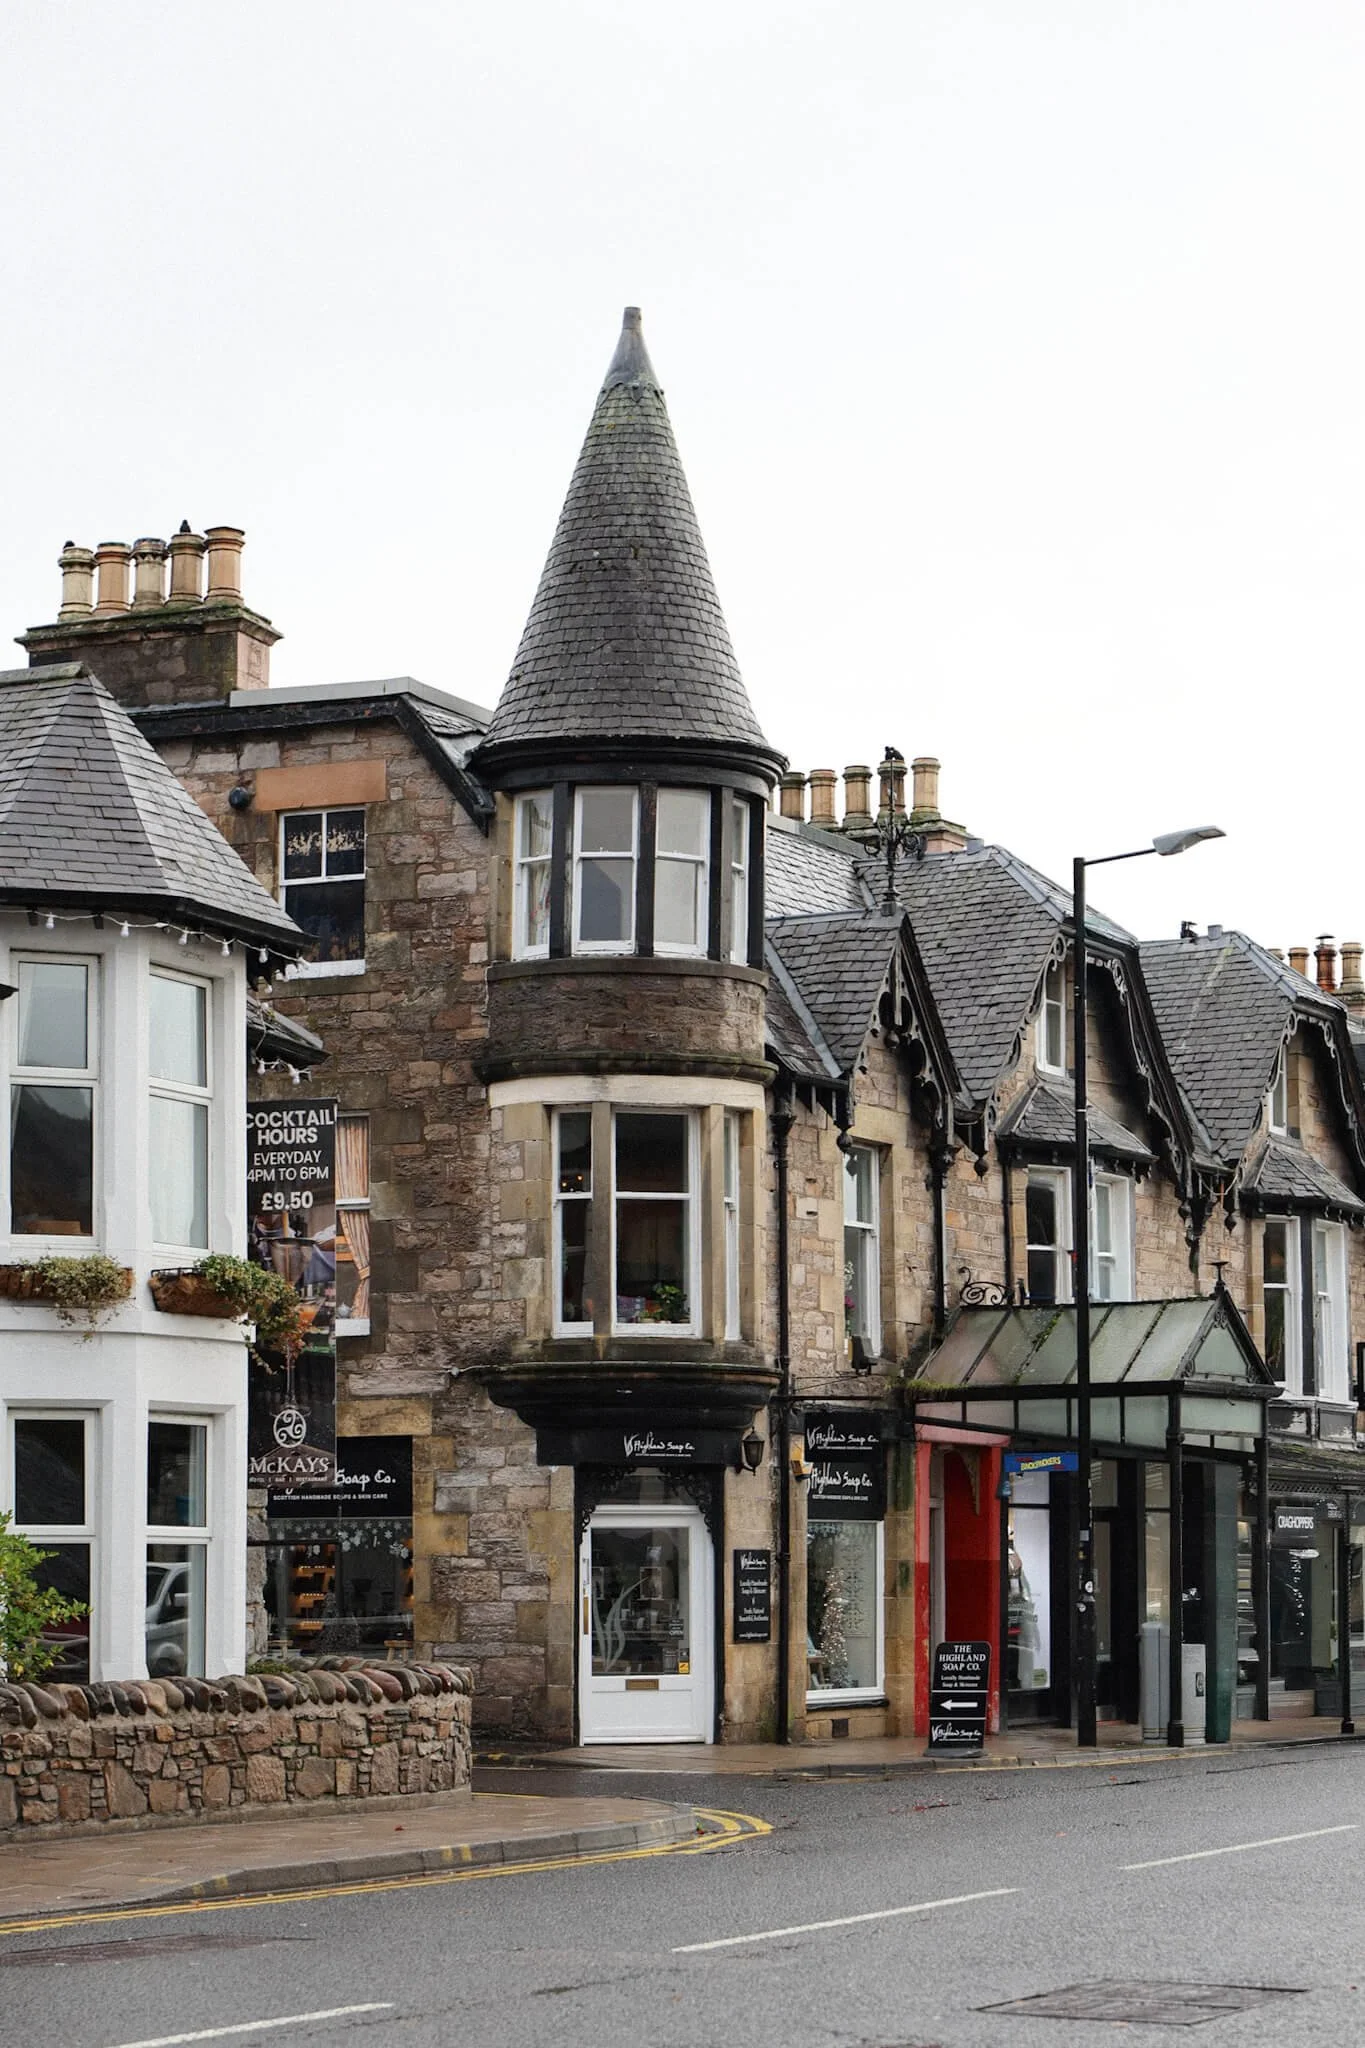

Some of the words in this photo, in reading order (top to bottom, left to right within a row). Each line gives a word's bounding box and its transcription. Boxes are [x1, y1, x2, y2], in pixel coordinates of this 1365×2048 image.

[246, 1108, 334, 1129] COCKTAIL
[257, 1127, 318, 1146] HOURS
[253, 1150, 322, 1166] EVERYDAY
[247, 1168, 275, 1183] 4PM
[279, 1167, 297, 1181] TO
[300, 1166, 329, 1180] 6PM
[261, 1190, 313, 1211] £9.50
[249, 1456, 331, 1474] McKAYS
[335, 1468, 370, 1492] Soap
[374, 1469, 397, 1483] Co.
[939, 1653, 987, 1662] HIGHLAND
[954, 1645, 972, 1653] THE
[942, 1663, 965, 1671] SOAP
[966, 1662, 981, 1671] CO.
